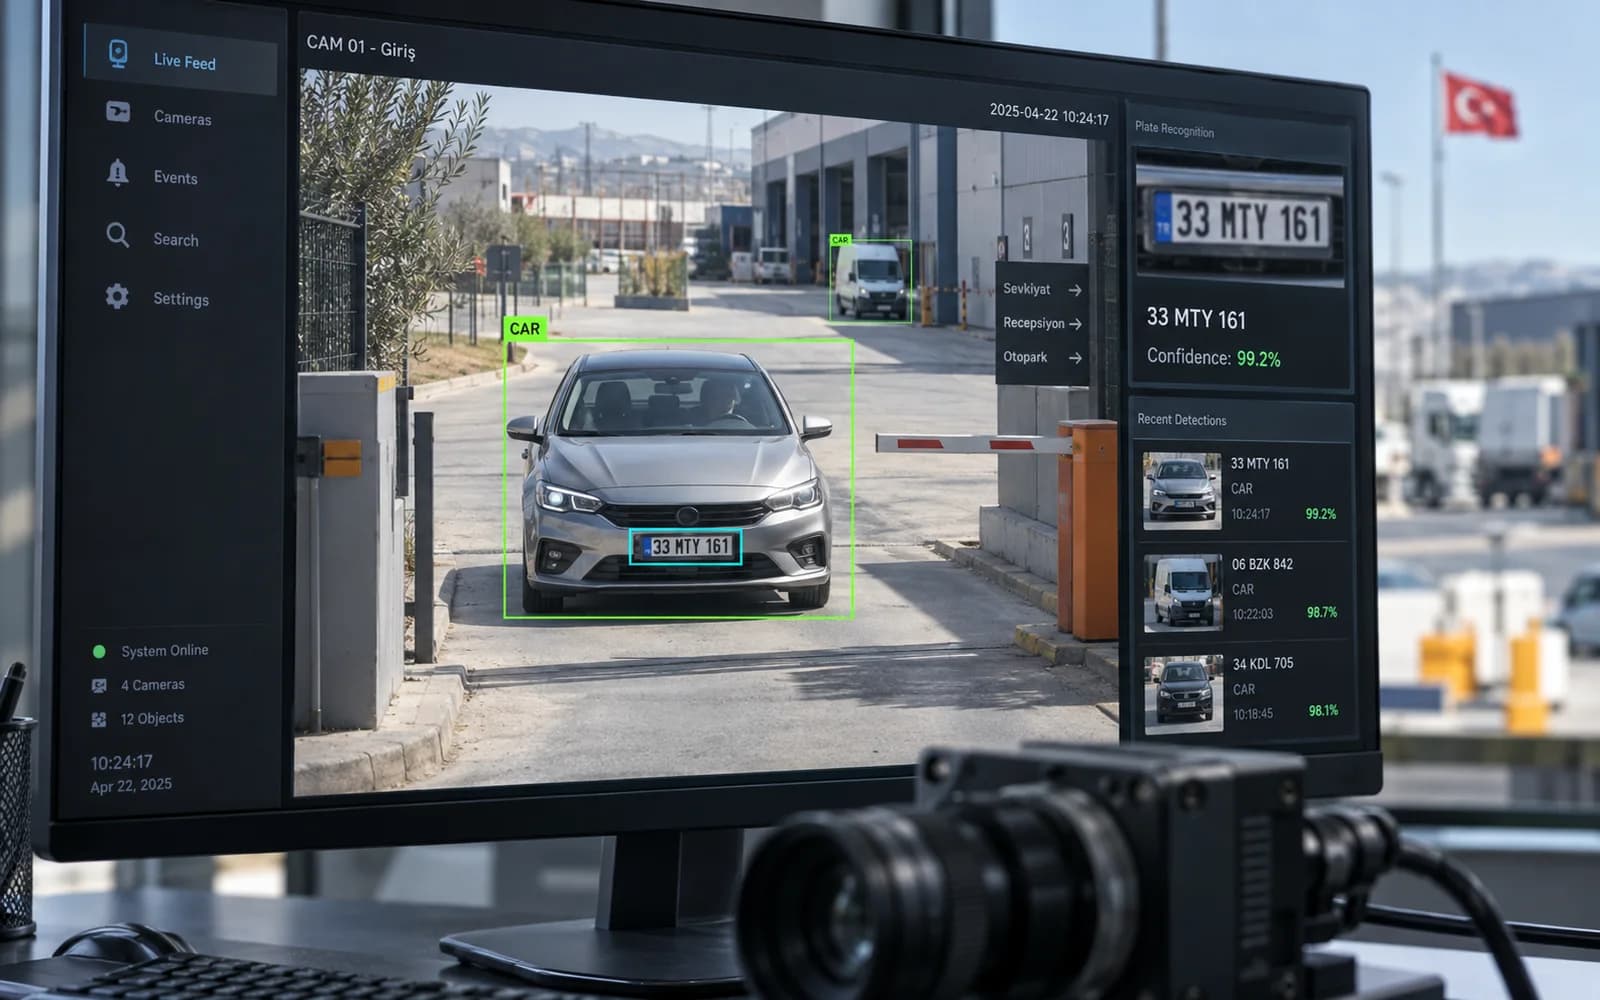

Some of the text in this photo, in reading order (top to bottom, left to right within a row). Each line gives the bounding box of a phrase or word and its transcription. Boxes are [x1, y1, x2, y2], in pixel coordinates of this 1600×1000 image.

[307, 34, 343, 52] CAM
[348, 40, 365, 55] 01
[381, 42, 416, 62] Giriş
[154, 52, 216, 72] Live Feed
[154, 109, 212, 127] Cameras
[990, 103, 1109, 126] 2025-04-22 10:24:17
[1135, 120, 1214, 139] Plate Recognition
[154, 170, 198, 186] Events
[1177, 200, 1320, 242] 33 MTY 161
[154, 232, 199, 248] Search
[1004, 283, 1050, 297] Sevkiyat
[154, 291, 209, 308] Settings
[1004, 316, 1065, 331] Recepsiyon
[1147, 307, 1246, 329] 33 MTY 161
[510, 322, 540, 336] CAR
[1004, 351, 1047, 365] Otopark
[1147, 347, 1281, 367] Confidence: 99.2%
[1138, 413, 1227, 426] Recent Detections
[1231, 458, 1289, 470] 33 MTY 161
[1231, 482, 1253, 495] CAR
[1231, 508, 1270, 520] 10:24:17
[1306, 507, 1337, 520] 99.2%
[653, 538, 728, 554] 33 MTY 161
[1232, 558, 1293, 570] 06 BZK 842
[1232, 583, 1254, 595] CAR
[1233, 608, 1273, 620] 10:22:03
[1307, 606, 1337, 619] 98.7%
[122, 644, 209, 660] System Online
[1233, 657, 1294, 670] 34 KDL 705
[121, 679, 185, 691] 4 Cameras
[1233, 683, 1255, 695] CAR
[1234, 707, 1273, 720] 10:18:45
[1309, 704, 1339, 717] 98.1%
[121, 712, 184, 726] 12 Objects
[91, 754, 153, 770] 10:24:17
[90, 777, 172, 796] Apr 22, 2025
